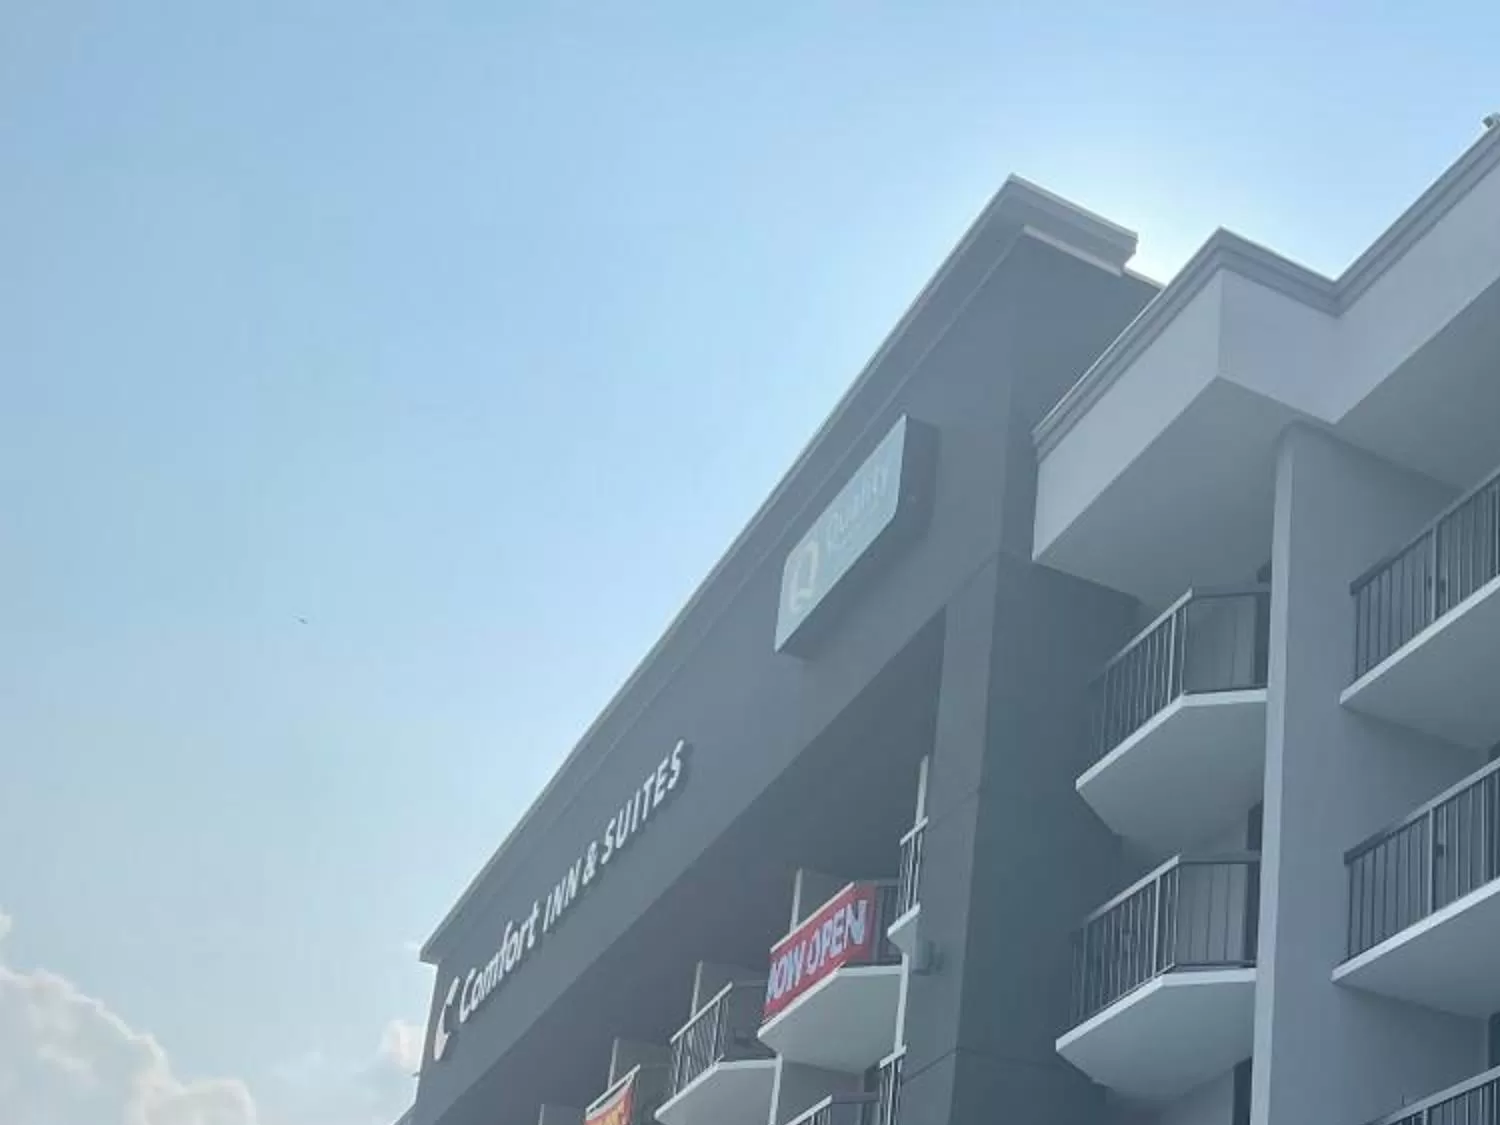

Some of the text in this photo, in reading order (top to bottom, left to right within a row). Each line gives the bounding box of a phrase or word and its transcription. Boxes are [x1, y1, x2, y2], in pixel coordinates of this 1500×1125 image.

[459, 898, 541, 1024] Comfort
[543, 857, 583, 933] INN
[582, 840, 600, 885] &
[601, 738, 685, 865] SUITES
[764, 899, 867, 1006] NOW OPEN
